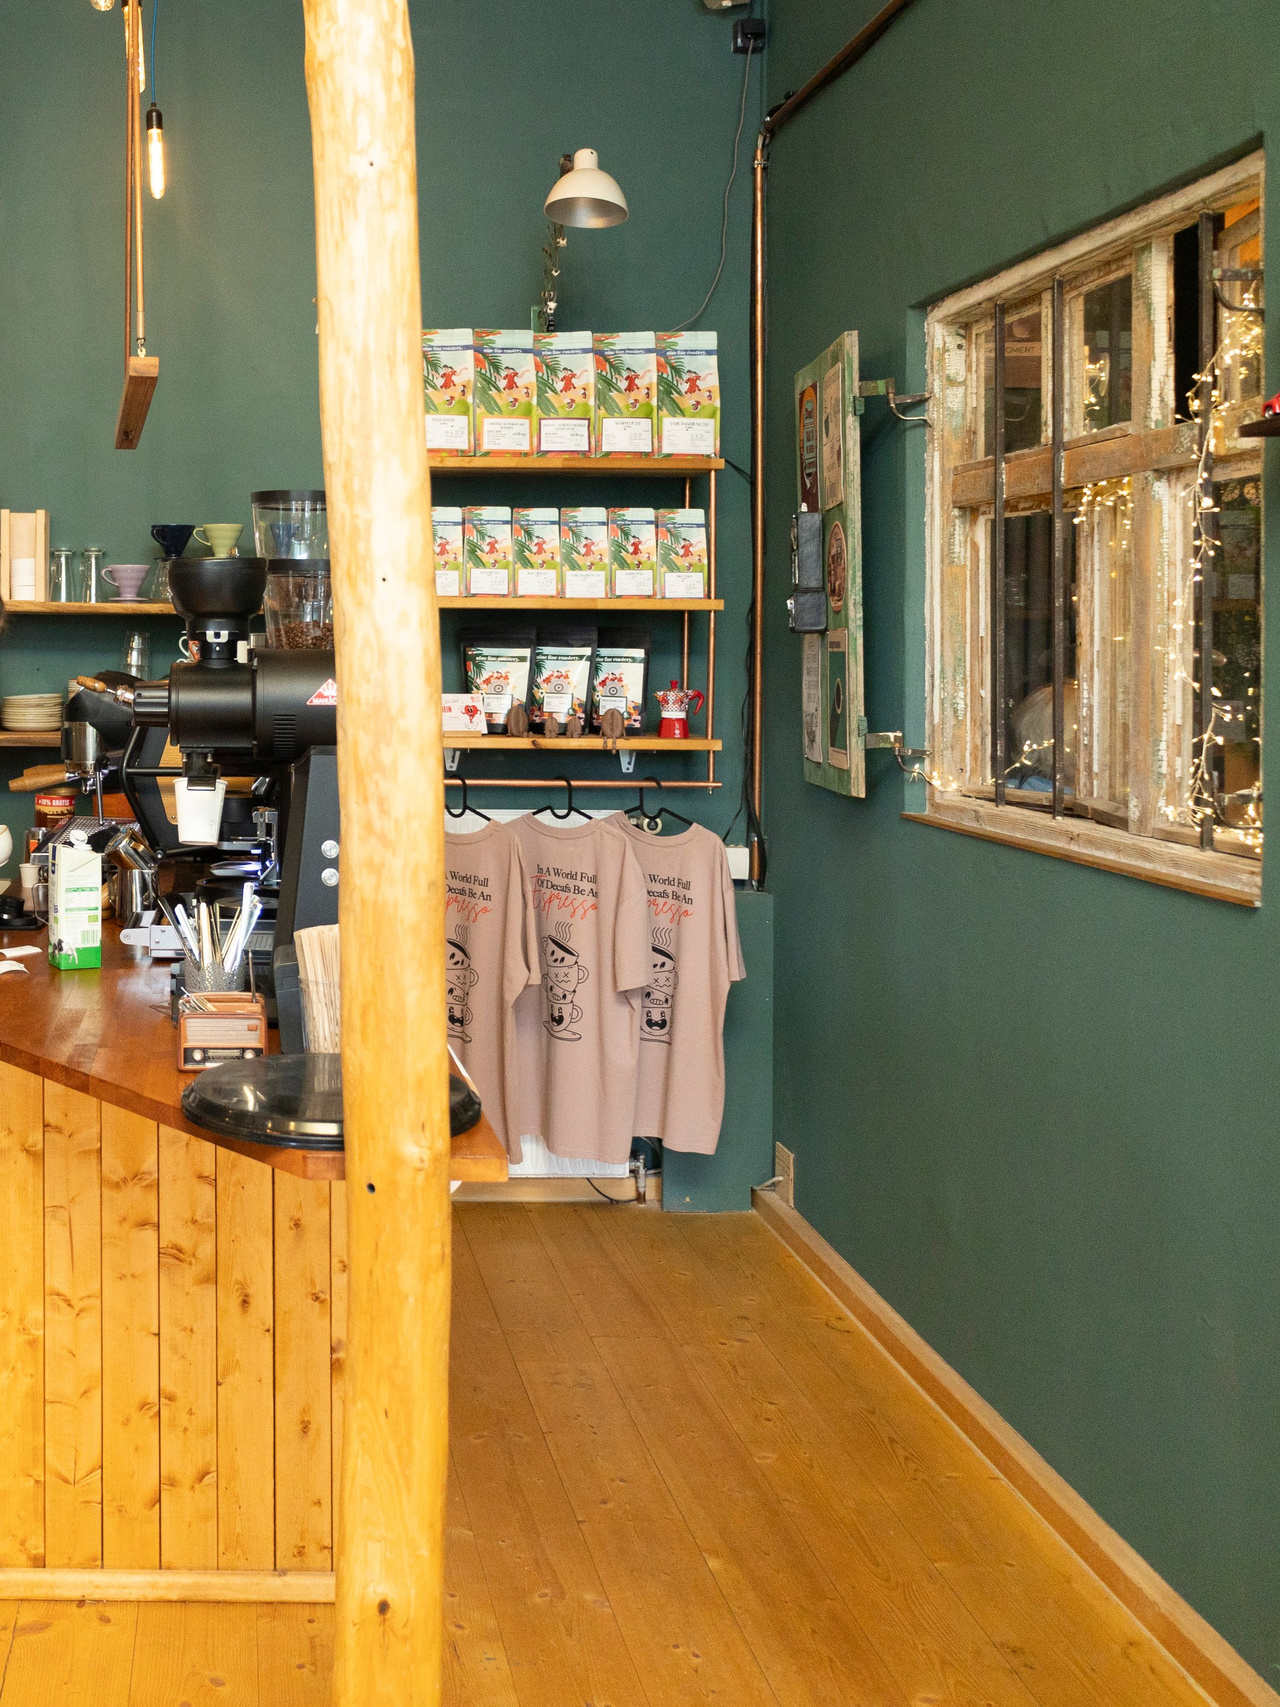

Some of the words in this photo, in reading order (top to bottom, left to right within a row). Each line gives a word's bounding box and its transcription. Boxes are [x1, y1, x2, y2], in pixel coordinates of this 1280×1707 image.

[1005, 346, 1035, 354] OMENT
[449, 870, 472, 884] World
[473, 876, 489, 887] Full
[536, 864, 544, 875] In
[544, 866, 551, 876] A
[552, 867, 577, 881] World
[579, 872, 597, 884] Full
[648, 873, 676, 887] World
[677, 877, 691, 891] Full
[468, 888, 477, 899] Be
[478, 891, 492, 901] An
[537, 877, 546, 888] Of
[545, 879, 571, 893] Decafs
[573, 884, 586, 895] Be
[647, 889, 670, 899] ecafs
[671, 890, 681, 902] Be
[681, 894, 693, 905] An
[445, 894, 493, 923] presso
